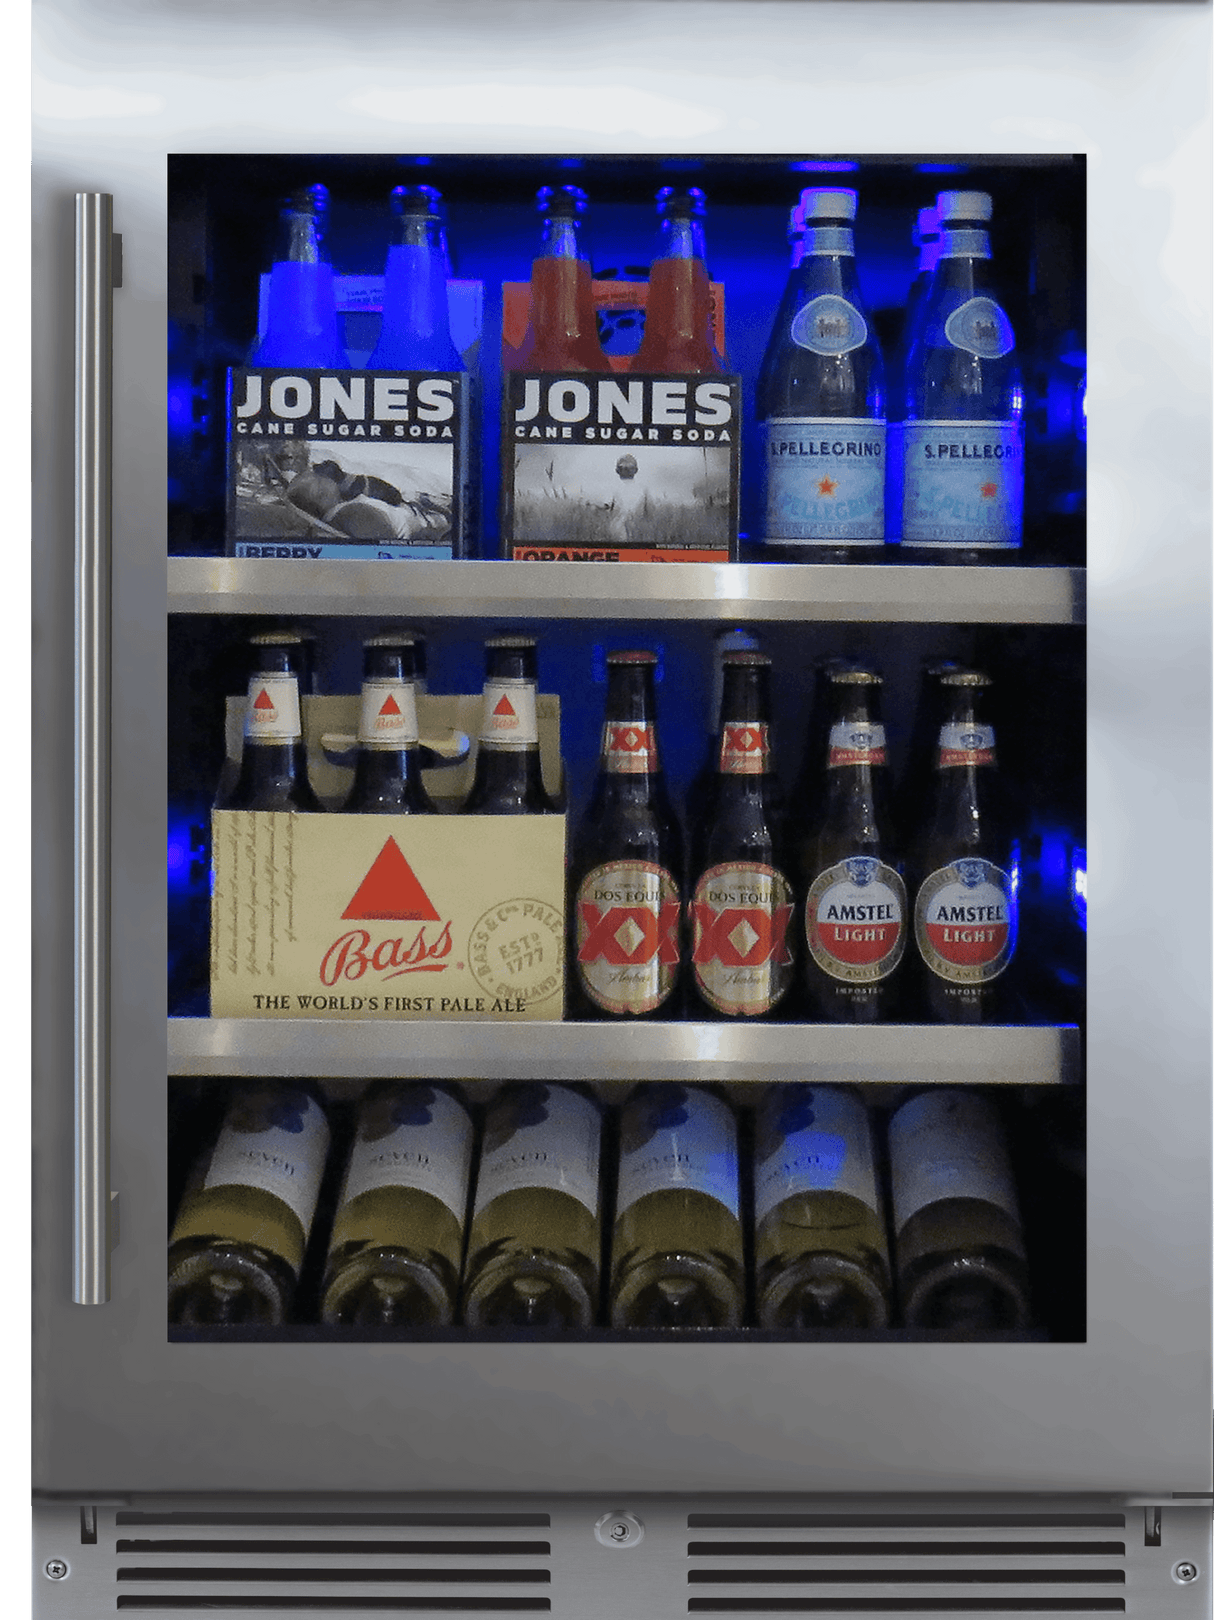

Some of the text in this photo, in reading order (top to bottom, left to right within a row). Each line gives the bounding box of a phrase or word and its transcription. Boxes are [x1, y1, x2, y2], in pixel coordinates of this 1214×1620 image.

[236, 375, 454, 422] JONES
[515, 379, 732, 426] JONES
[236, 422, 454, 438] CANE SUGAR SODA
[515, 426, 731, 442] CANE SUGAR SODA
[522, 550, 620, 561] ORANGE
[709, 891, 736, 903] DOS
[826, 903, 894, 920] AMSTEL
[936, 905, 1004, 922] AMSTEL
[834, 926, 887, 942] LIGHT
[943, 928, 997, 943] LIGHT
[319, 920, 453, 987] Bass
[252, 994, 527, 1013] THE WORLD'S FIRST PALE ALE
